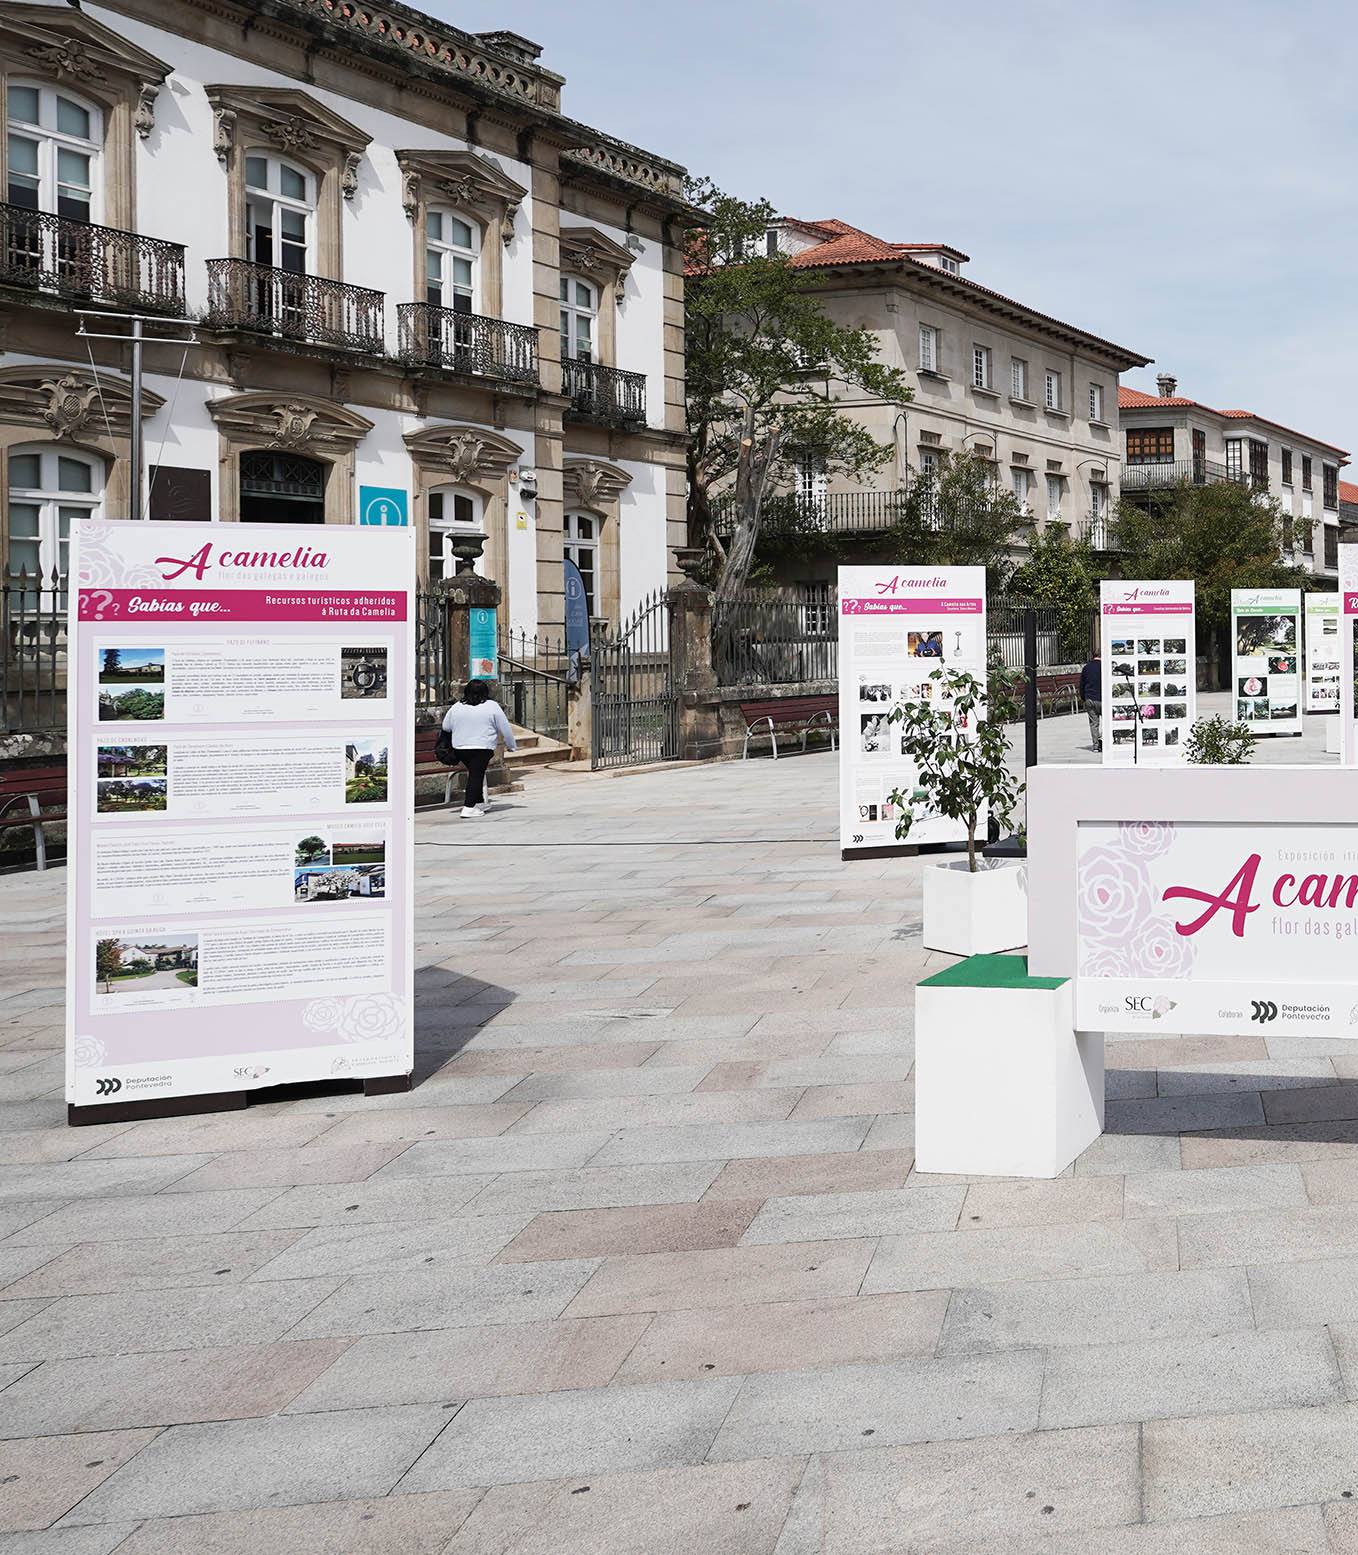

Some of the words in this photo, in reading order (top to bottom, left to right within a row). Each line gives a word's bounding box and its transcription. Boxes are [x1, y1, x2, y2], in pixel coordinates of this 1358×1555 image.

[155, 542, 213, 581] A
[219, 546, 330, 568] camelia
[874, 575, 899, 595] A
[901, 577, 948, 588] camelia
[265, 595, 306, 605] Recursos
[354, 596, 396, 605] adheridos
[1124, 587, 1139, 601] A
[128, 596, 184, 613] Sabías
[328, 607, 348, 616] Ruta
[350, 607, 360, 616] da
[362, 607, 396, 616] Camelia
[864, 602, 888, 611] Sabías
[1278, 848, 1335, 863] Exposición
[1162, 853, 1262, 938] A
[1272, 917, 1300, 935] flor
[1304, 918, 1330, 936] das
[1125, 996, 1152, 1012] SEC
[1282, 1004, 1330, 1014] Deputación
[1282, 1013, 1330, 1021] Pontevedra
[126, 1075, 173, 1084] Deputación
[126, 1081, 173, 1090] Pontevedra
